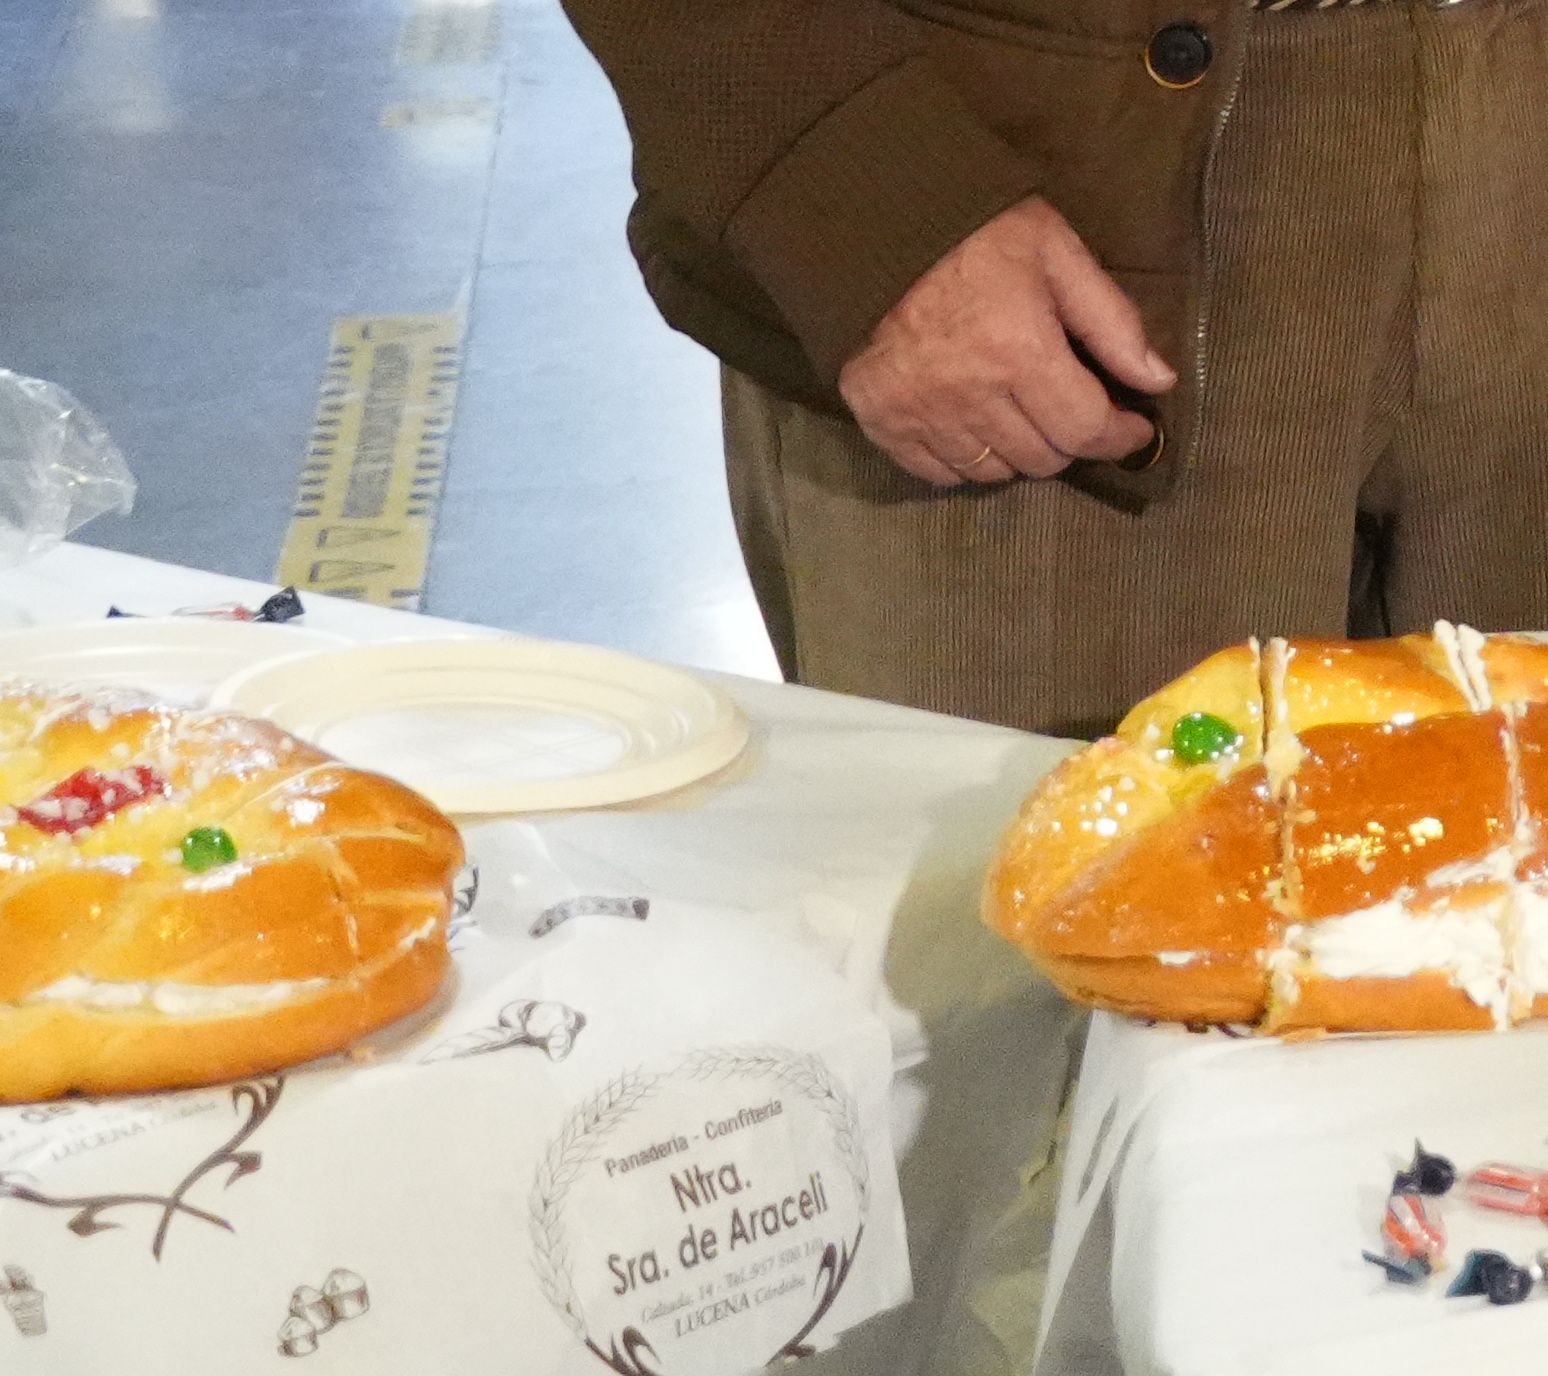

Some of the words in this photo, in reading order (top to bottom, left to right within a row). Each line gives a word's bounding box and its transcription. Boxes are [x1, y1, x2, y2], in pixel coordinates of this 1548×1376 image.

[669, 1162, 752, 1214] Ntra.
[607, 1249, 671, 1297] Sra.
[678, 1223, 718, 1270] de
[729, 1170, 829, 1252] Araceli
[674, 1291, 750, 1338] LUCENA
